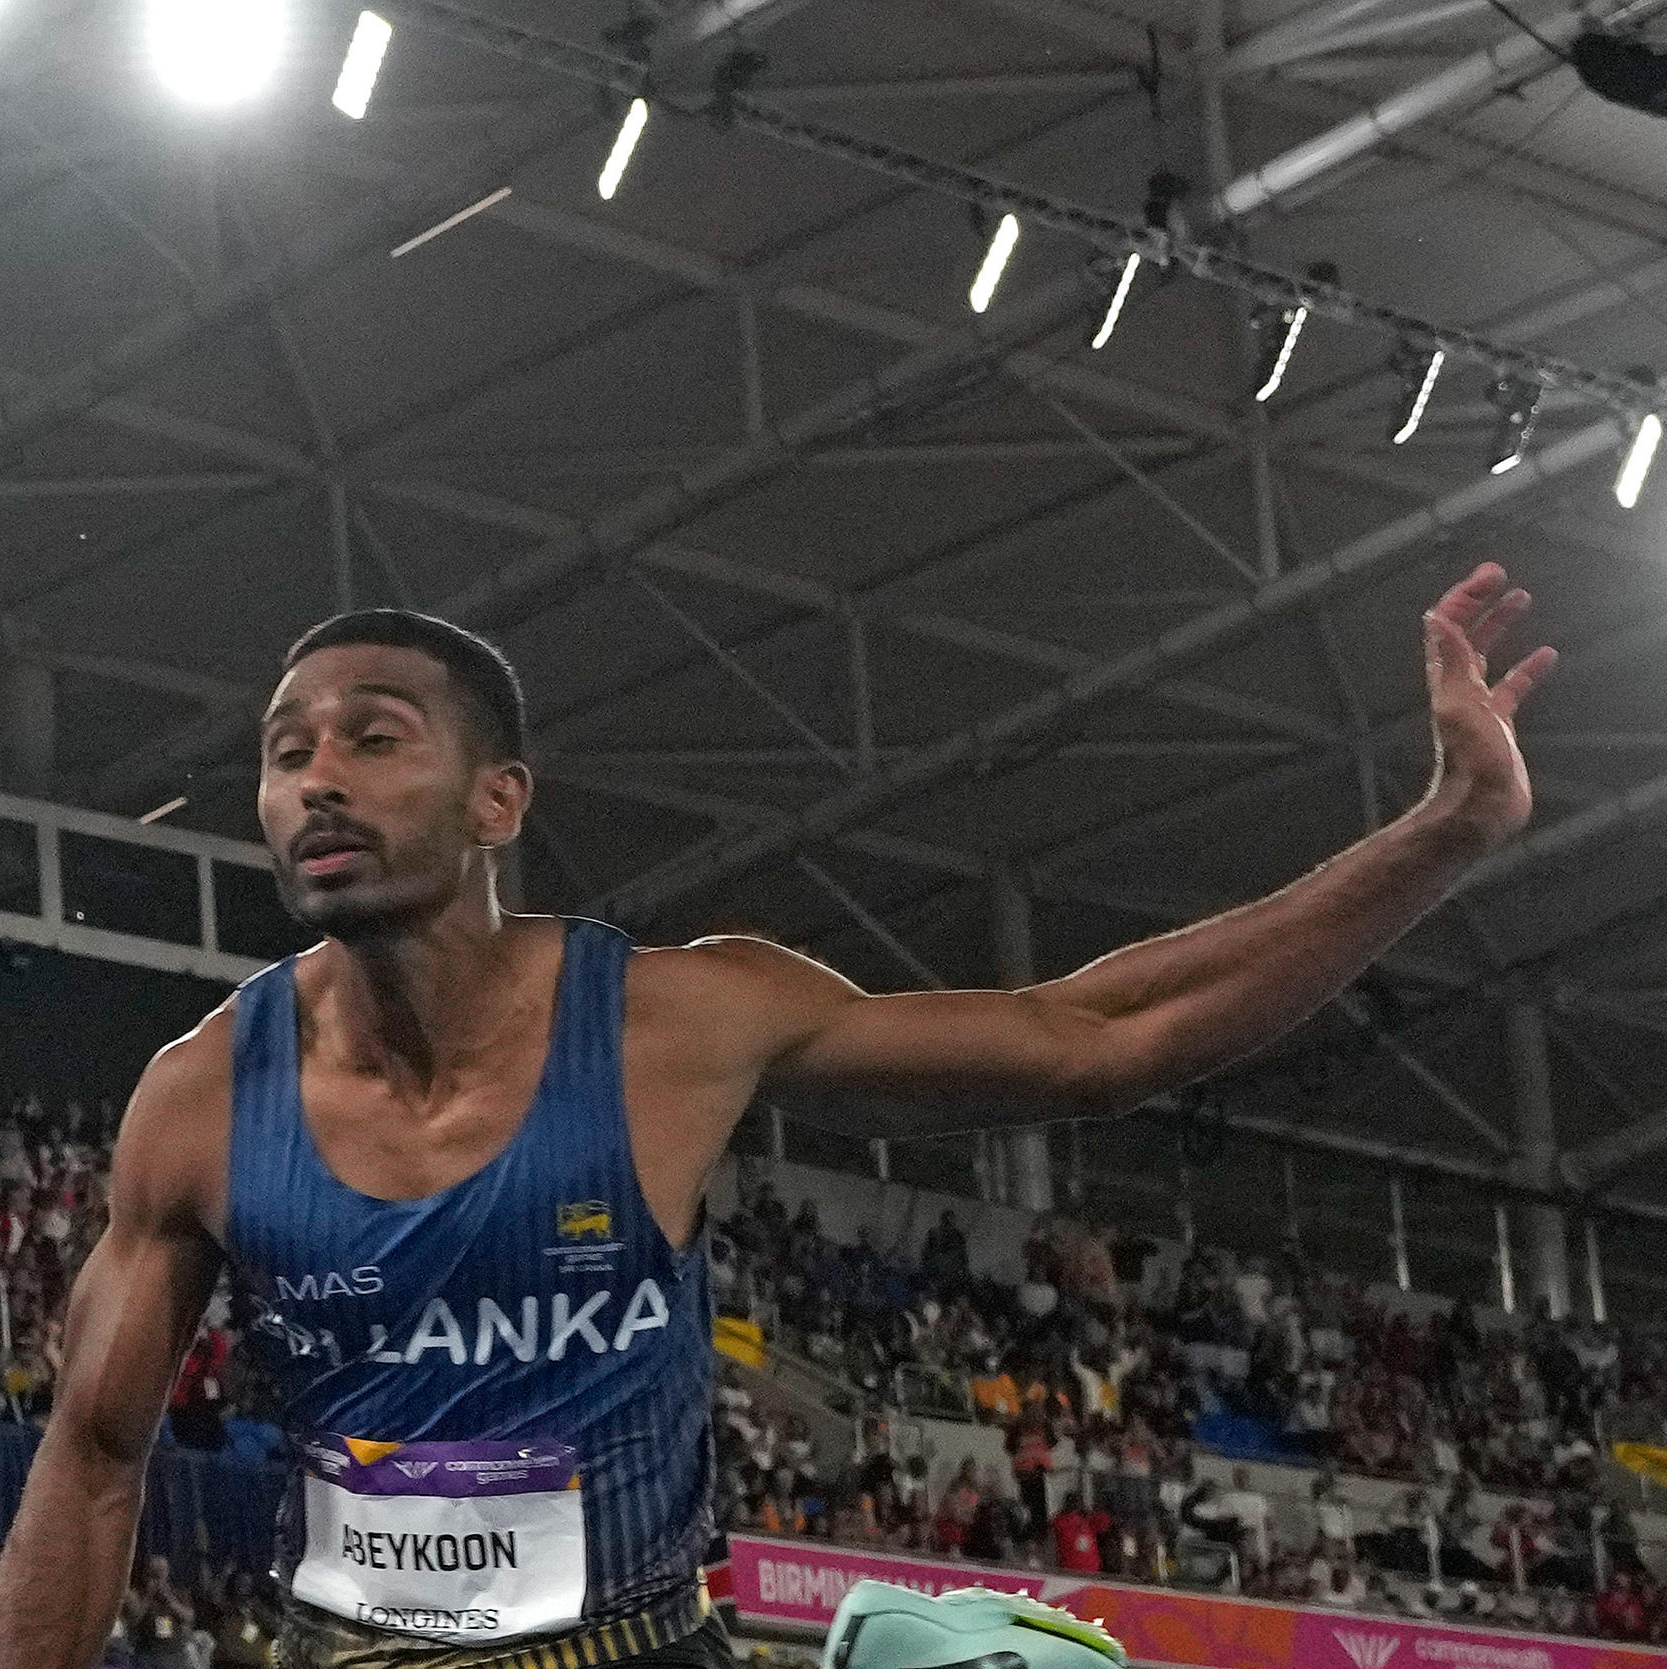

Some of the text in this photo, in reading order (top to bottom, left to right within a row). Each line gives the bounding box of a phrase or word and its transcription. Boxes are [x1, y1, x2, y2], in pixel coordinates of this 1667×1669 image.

[275, 1266, 385, 1302] MAS
[343, 1523, 518, 1572] ABEYKOON
[355, 1602, 500, 1630] LONGINES
